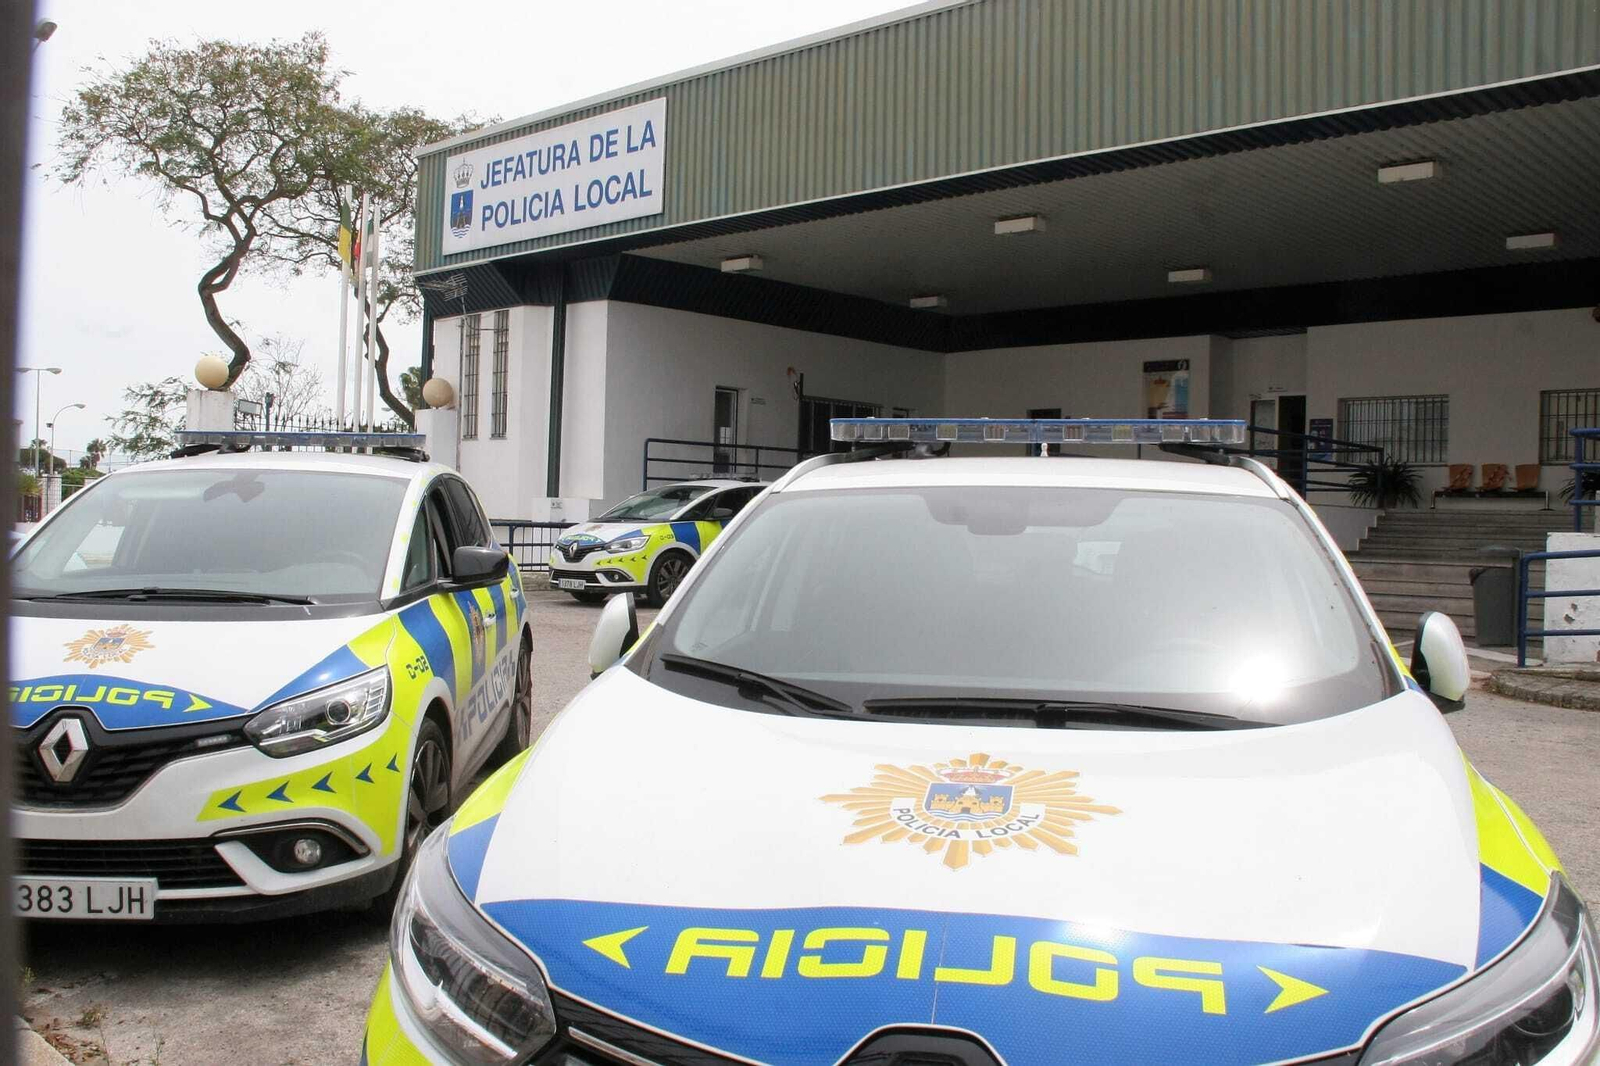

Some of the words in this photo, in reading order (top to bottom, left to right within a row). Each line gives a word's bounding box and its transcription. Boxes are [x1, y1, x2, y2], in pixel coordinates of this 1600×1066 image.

[480, 140, 581, 189] JEFATURA
[589, 128, 619, 163] DE
[626, 120, 656, 154] LA
[481, 188, 565, 231] POLICIA
[574, 169, 653, 212] LOCAL
[467, 654, 510, 736] POLICIA
[893, 807, 961, 839] POLICIA
[976, 812, 1040, 839] LOCAL
[18, 885, 73, 913] 383
[87, 886, 144, 914] LJH
